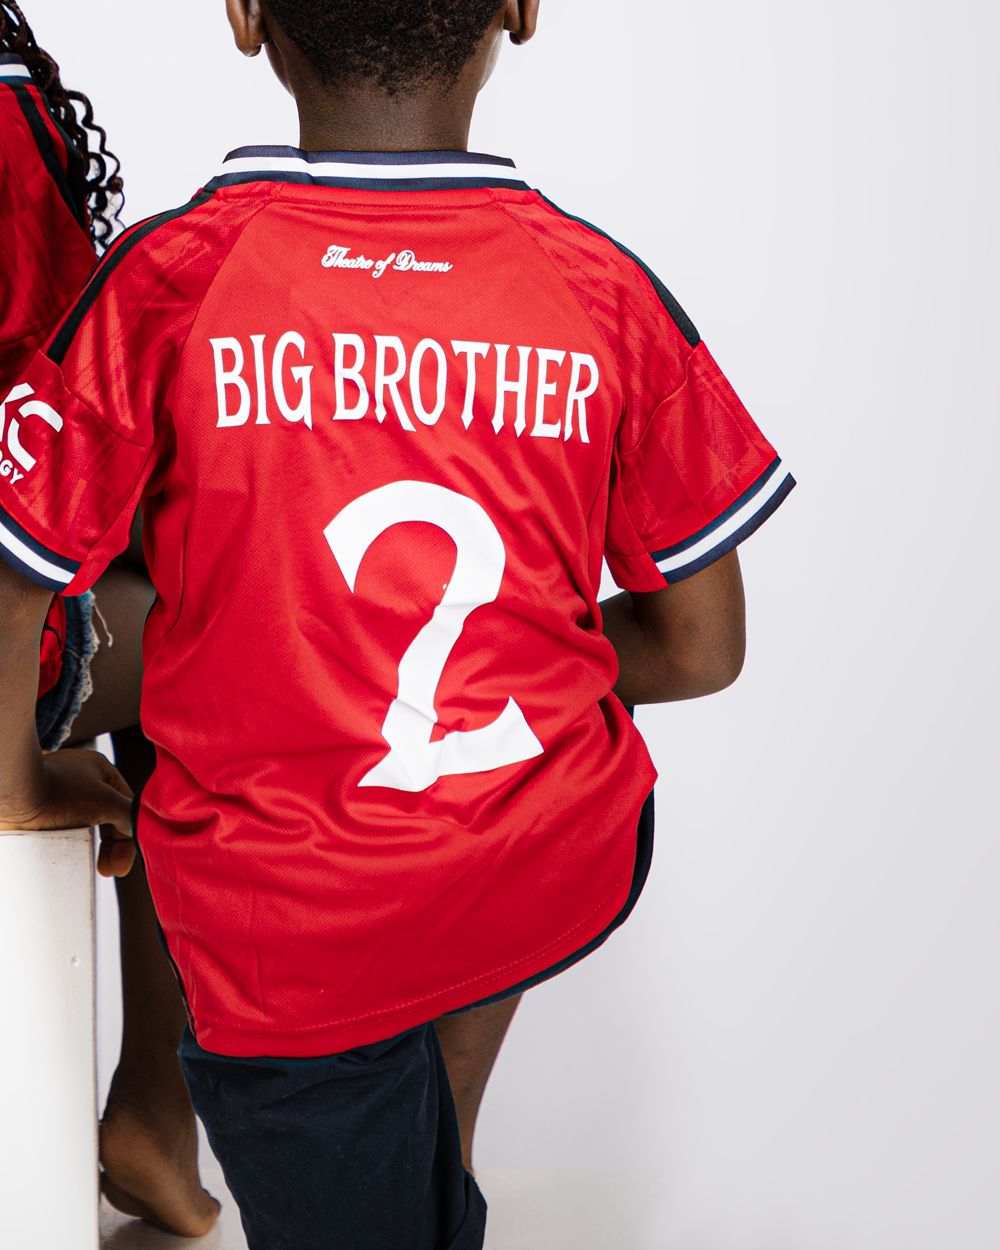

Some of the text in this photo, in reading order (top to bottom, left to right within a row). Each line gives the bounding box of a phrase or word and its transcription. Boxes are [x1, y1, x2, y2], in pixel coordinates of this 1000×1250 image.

[321, 244, 454, 279] Theatre of Dreams
[208, 330, 600, 444] BIG BROTHER
[322, 479, 545, 793] 2
